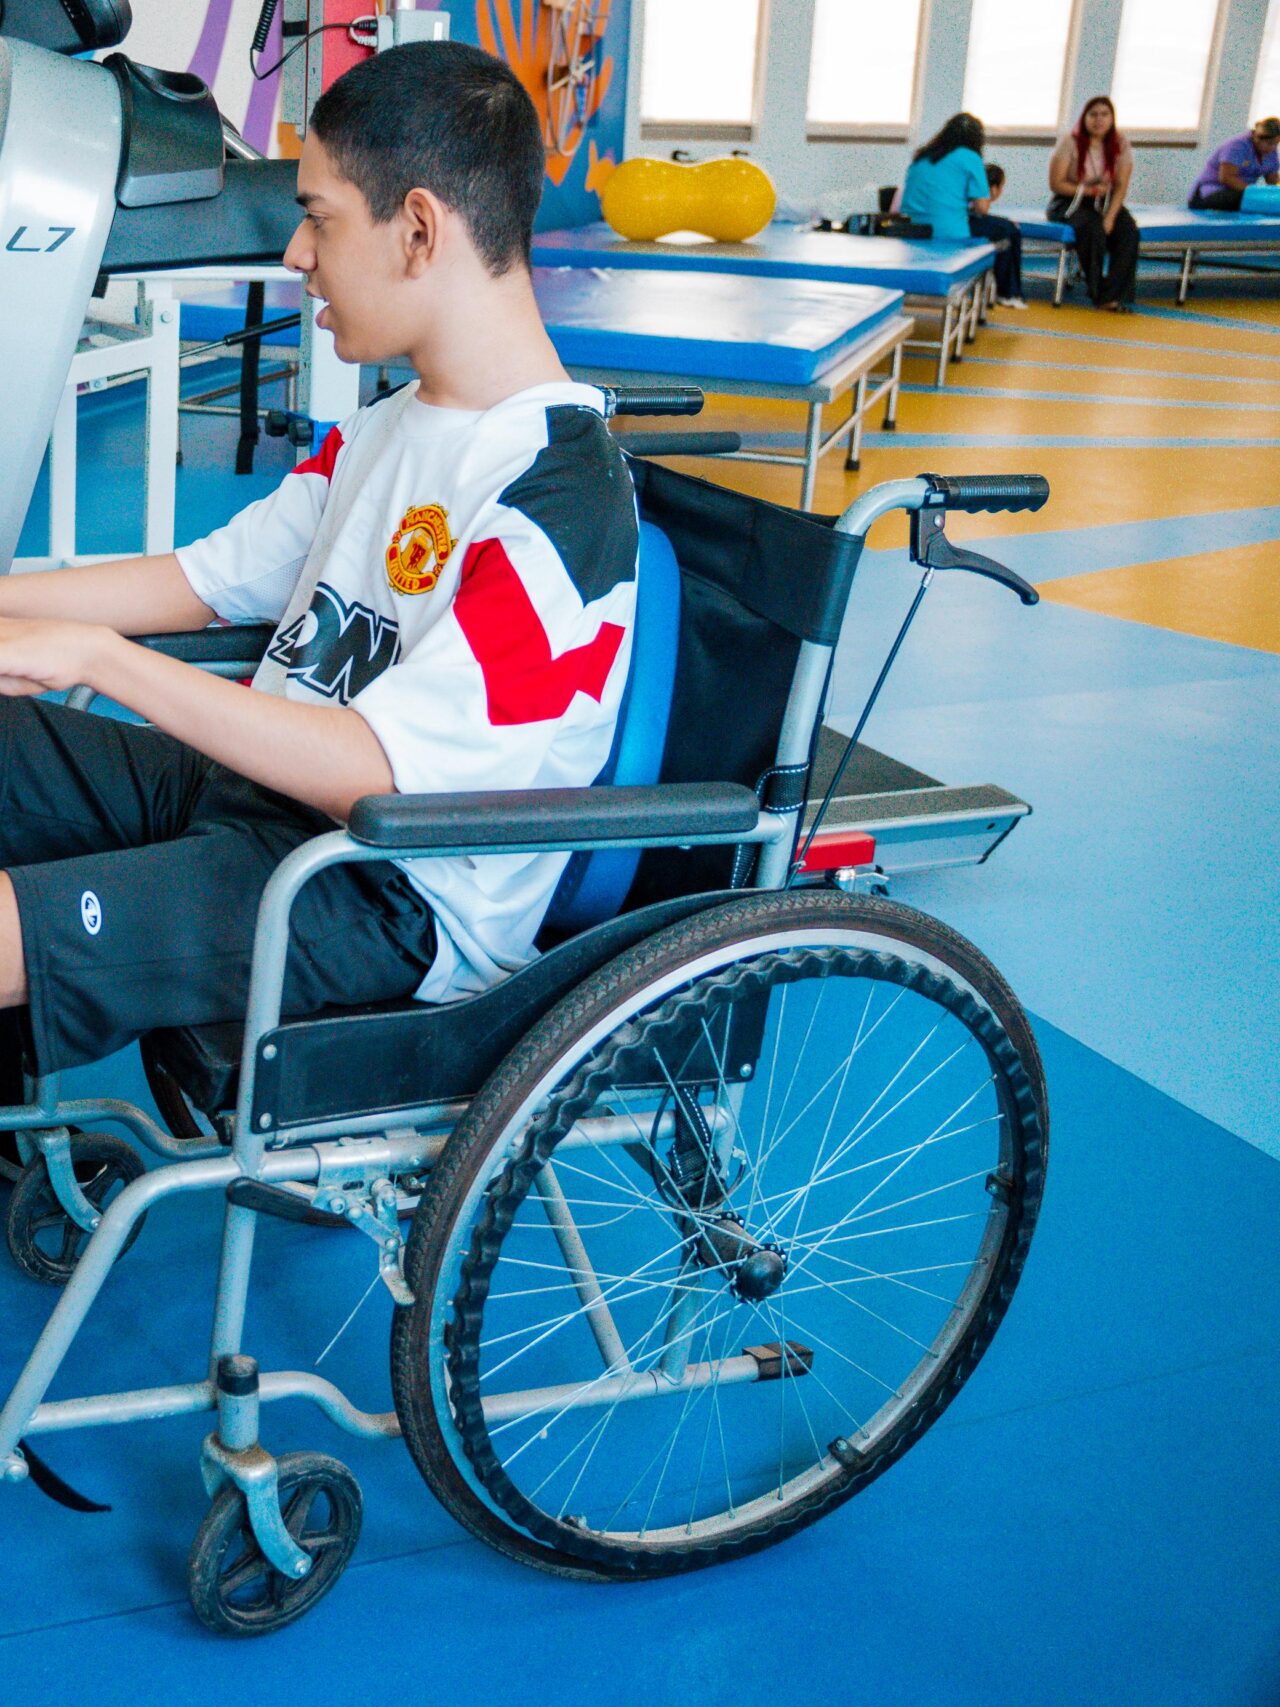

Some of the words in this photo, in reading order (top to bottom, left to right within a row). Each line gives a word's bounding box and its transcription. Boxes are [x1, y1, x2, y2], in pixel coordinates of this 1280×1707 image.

[6, 226, 76, 253] L7
[405, 508, 448, 552] MANCHESTER
[389, 558, 420, 591] UNITED
